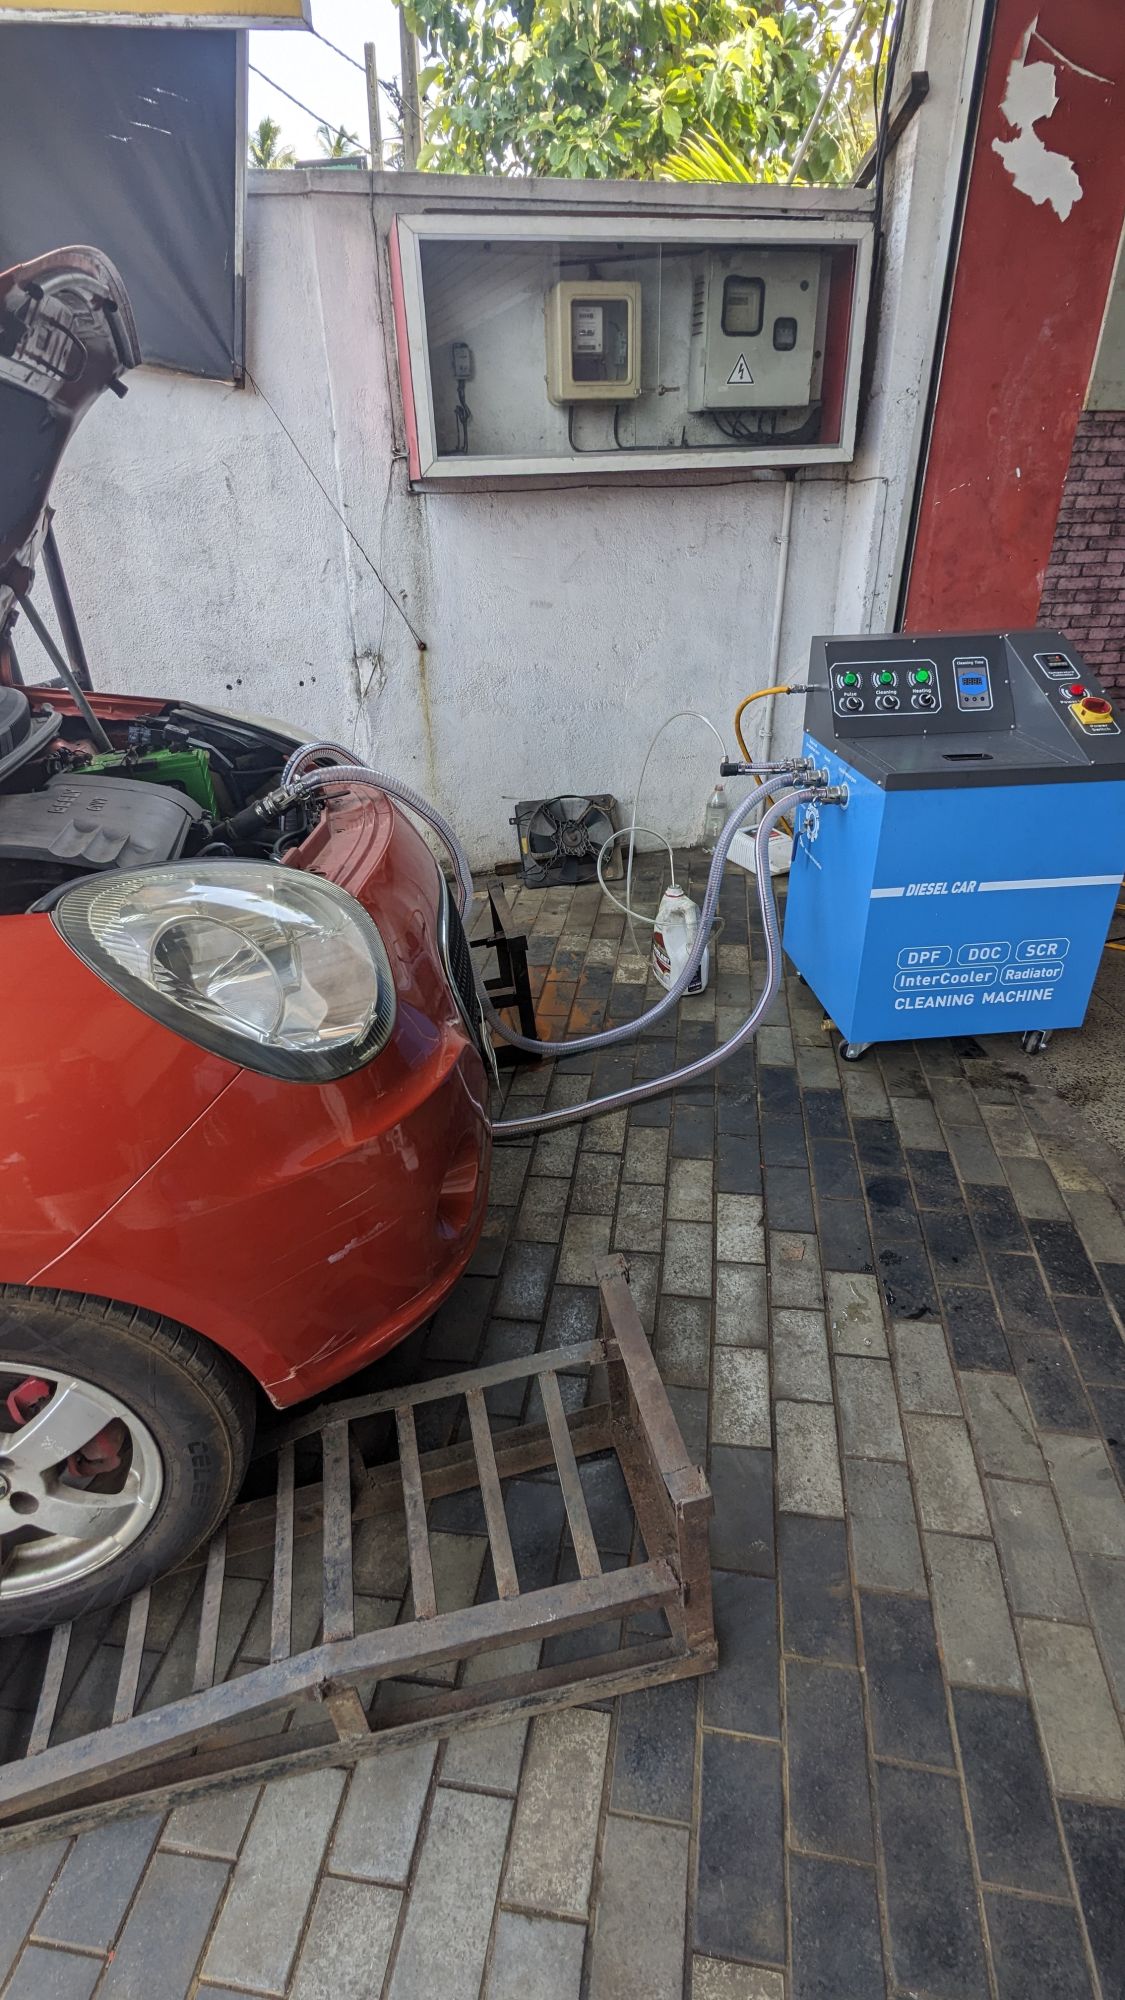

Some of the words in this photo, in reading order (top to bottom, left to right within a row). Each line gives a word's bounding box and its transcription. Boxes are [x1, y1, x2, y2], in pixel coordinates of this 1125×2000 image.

[905, 882, 949, 897] DIESEL
[951, 880, 977, 894] CAR
[907, 950, 941, 965] DPF
[968, 946, 1002, 961] DOC
[1025, 943, 1058, 957] SCR
[900, 971, 993, 987] InterCooler
[1005, 967, 1060, 980] Radiator
[894, 993, 975, 1010] CLEANING
[981, 988, 1054, 1004] MACHINE
